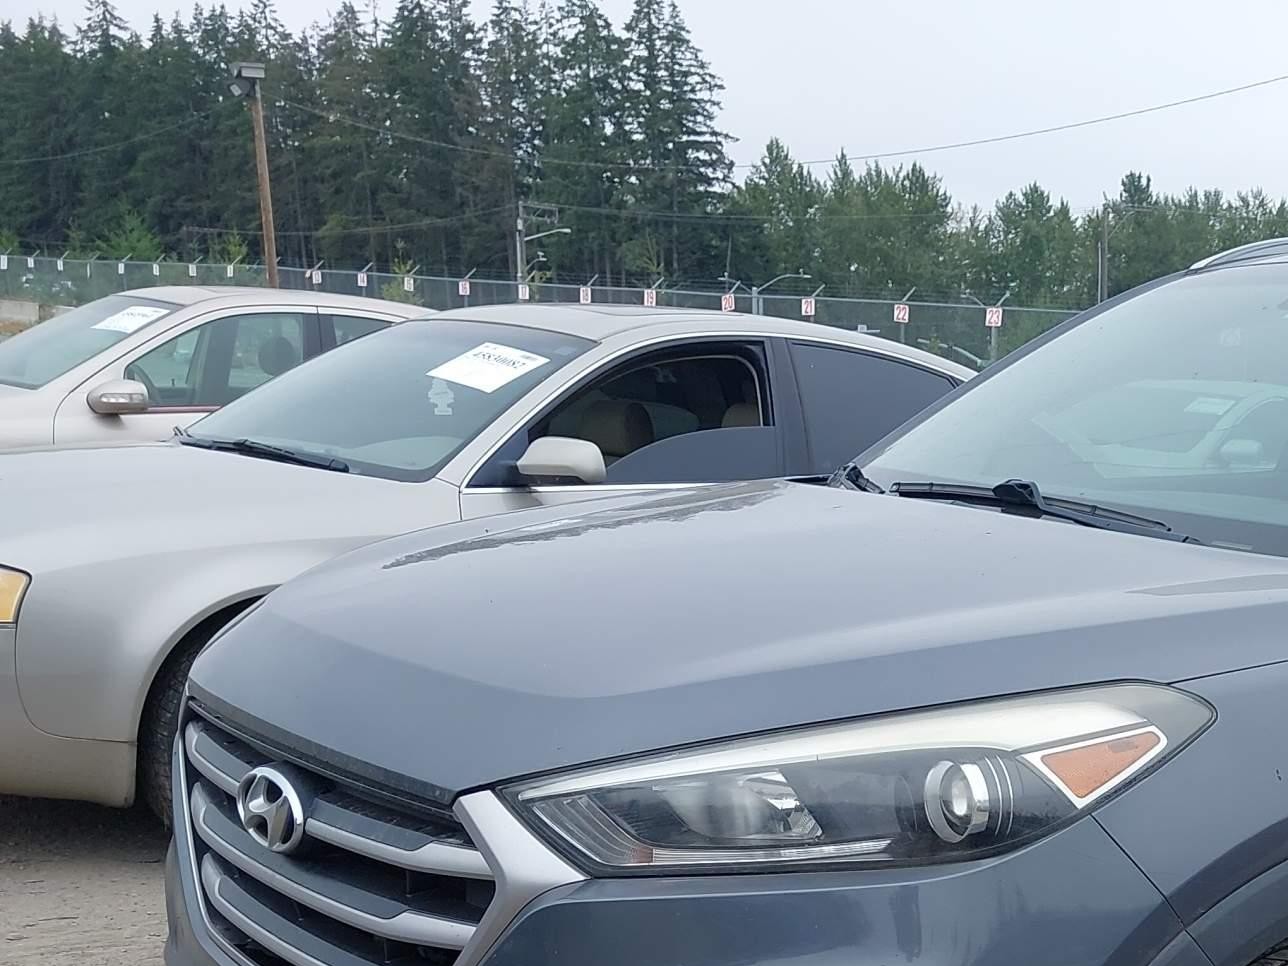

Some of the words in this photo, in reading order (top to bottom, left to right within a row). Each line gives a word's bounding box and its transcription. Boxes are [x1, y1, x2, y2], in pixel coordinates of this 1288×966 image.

[646, 291, 655, 305] 19
[722, 295, 734, 310] 20
[803, 300, 813, 314] 21
[895, 306, 907, 321] 22
[987, 310, 1000, 325] 23
